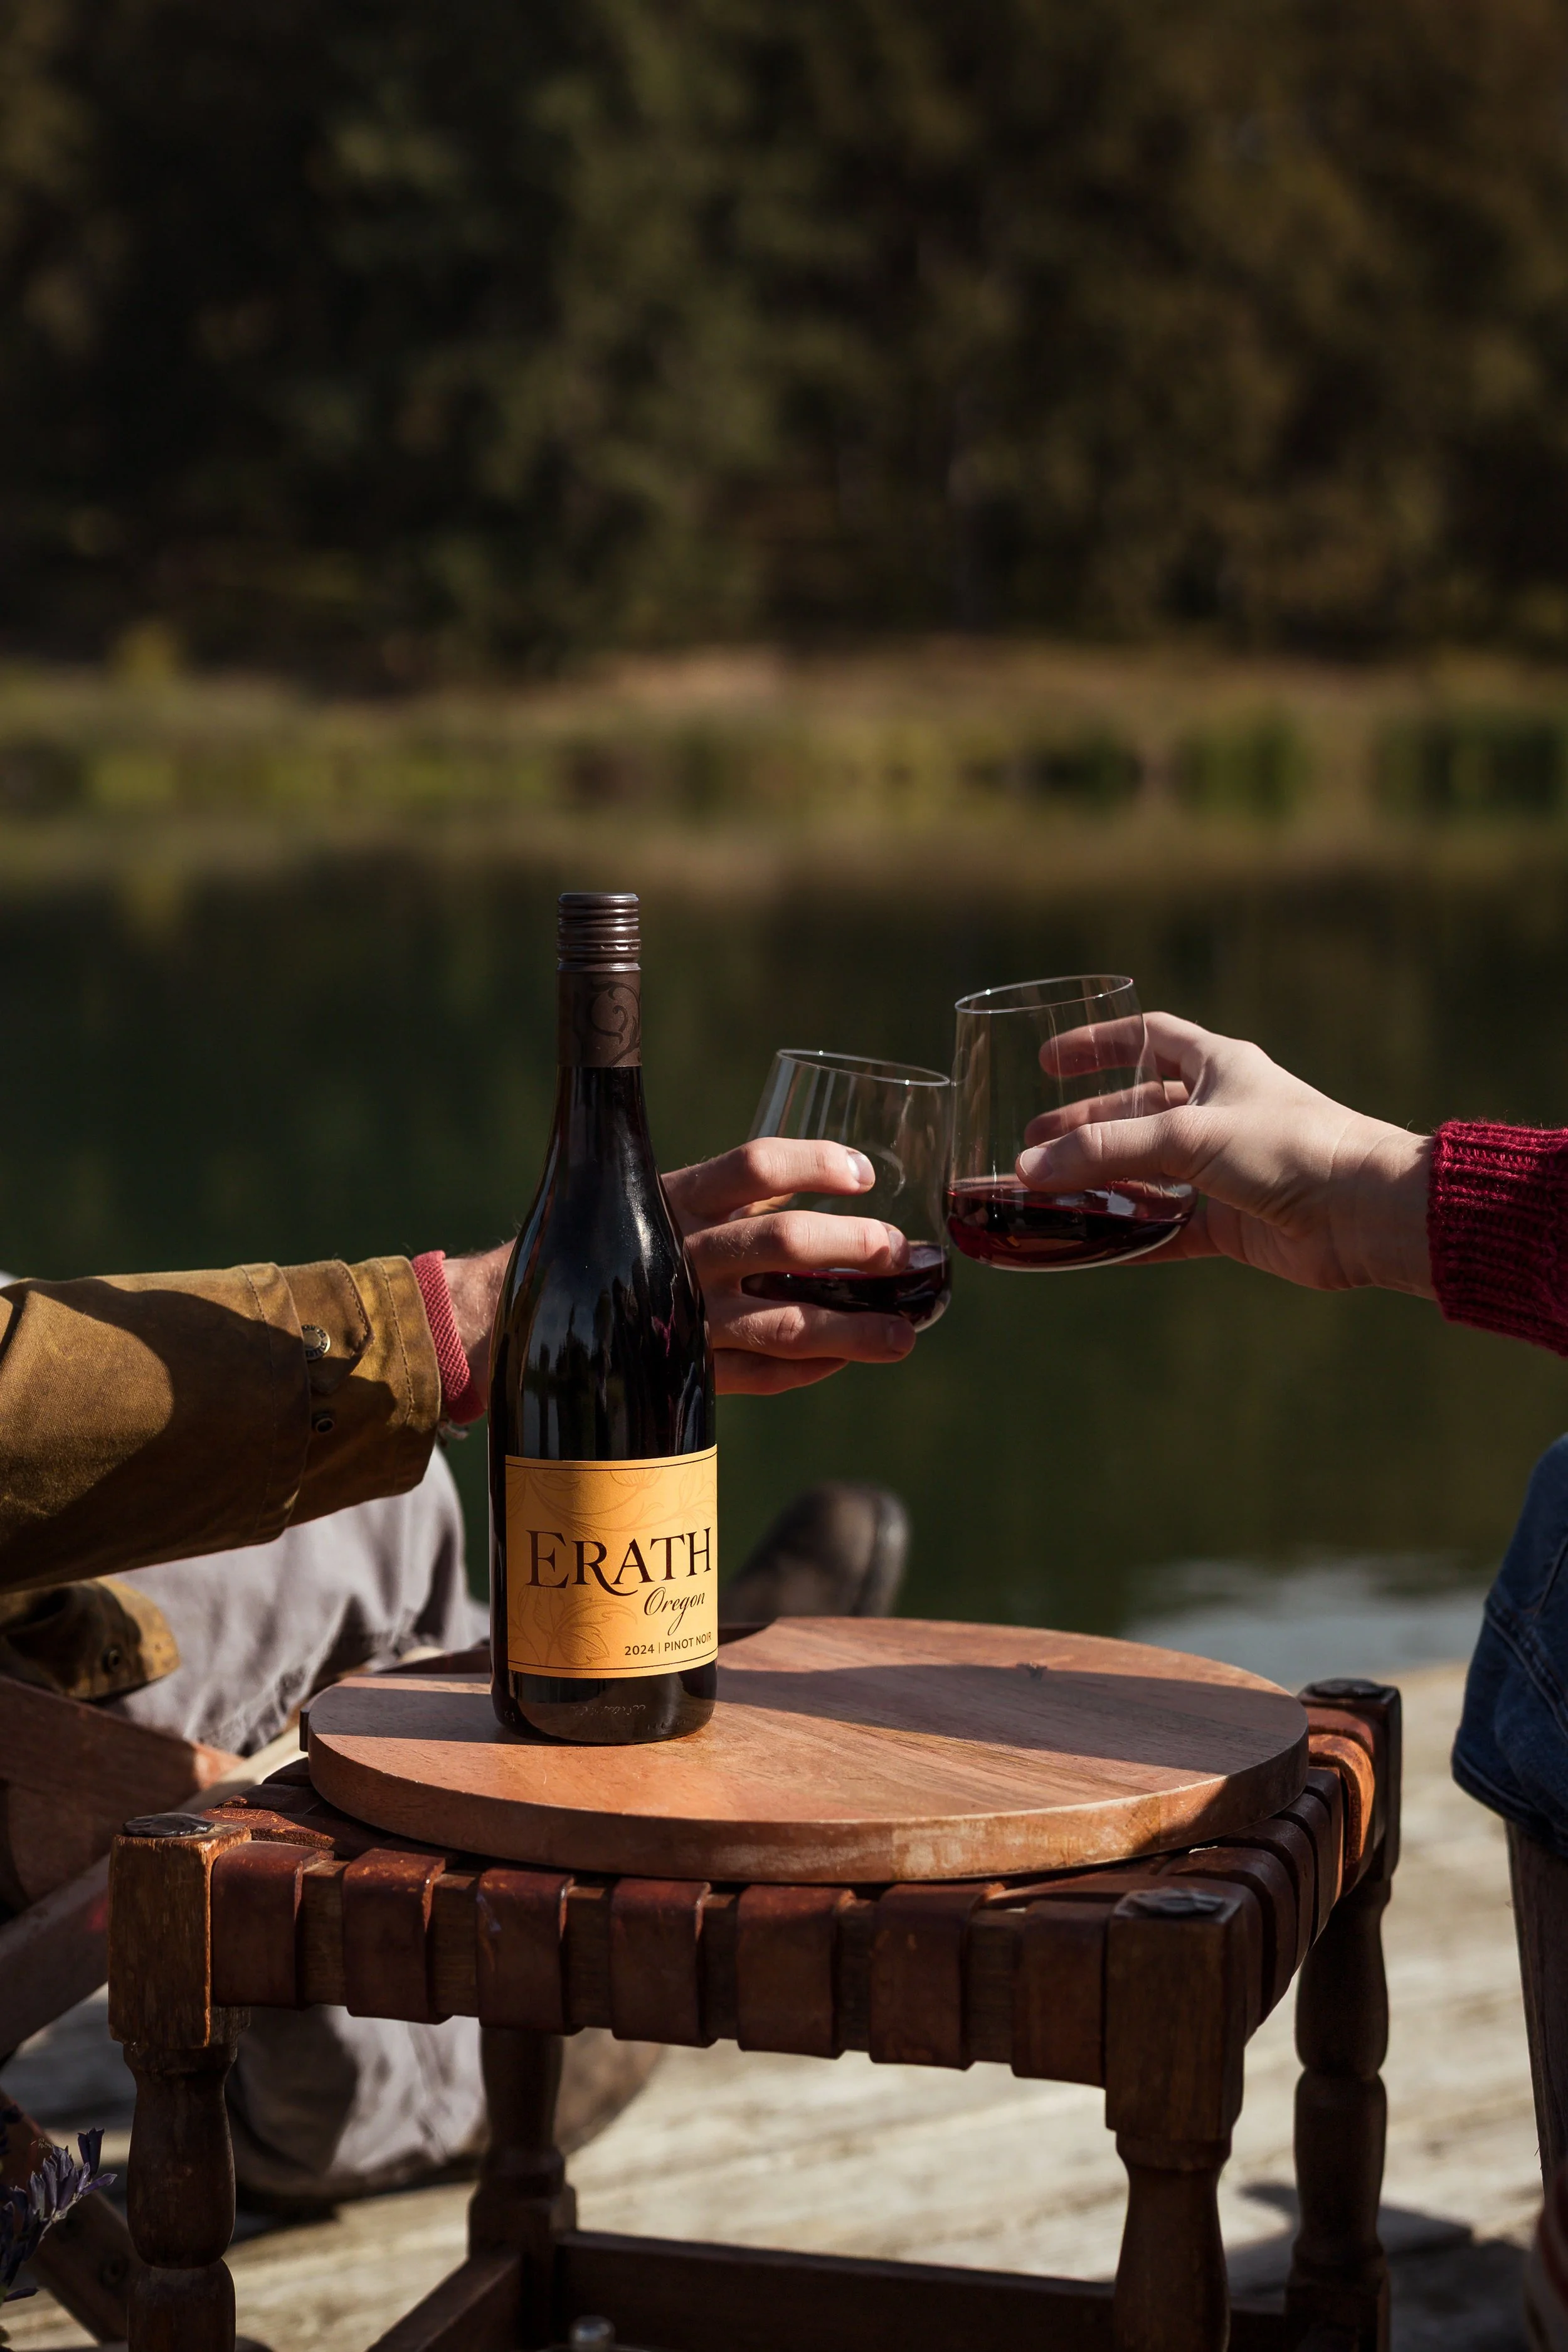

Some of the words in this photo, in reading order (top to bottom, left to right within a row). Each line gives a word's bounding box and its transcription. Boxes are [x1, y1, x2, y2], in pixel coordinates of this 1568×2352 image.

[526, 1527, 712, 1596] ERATH
[644, 1586, 705, 1636] Oregon
[625, 1644, 655, 1656] 2024
[664, 1638, 694, 1652] PINOT
[696, 1631, 712, 1646] NOIR
